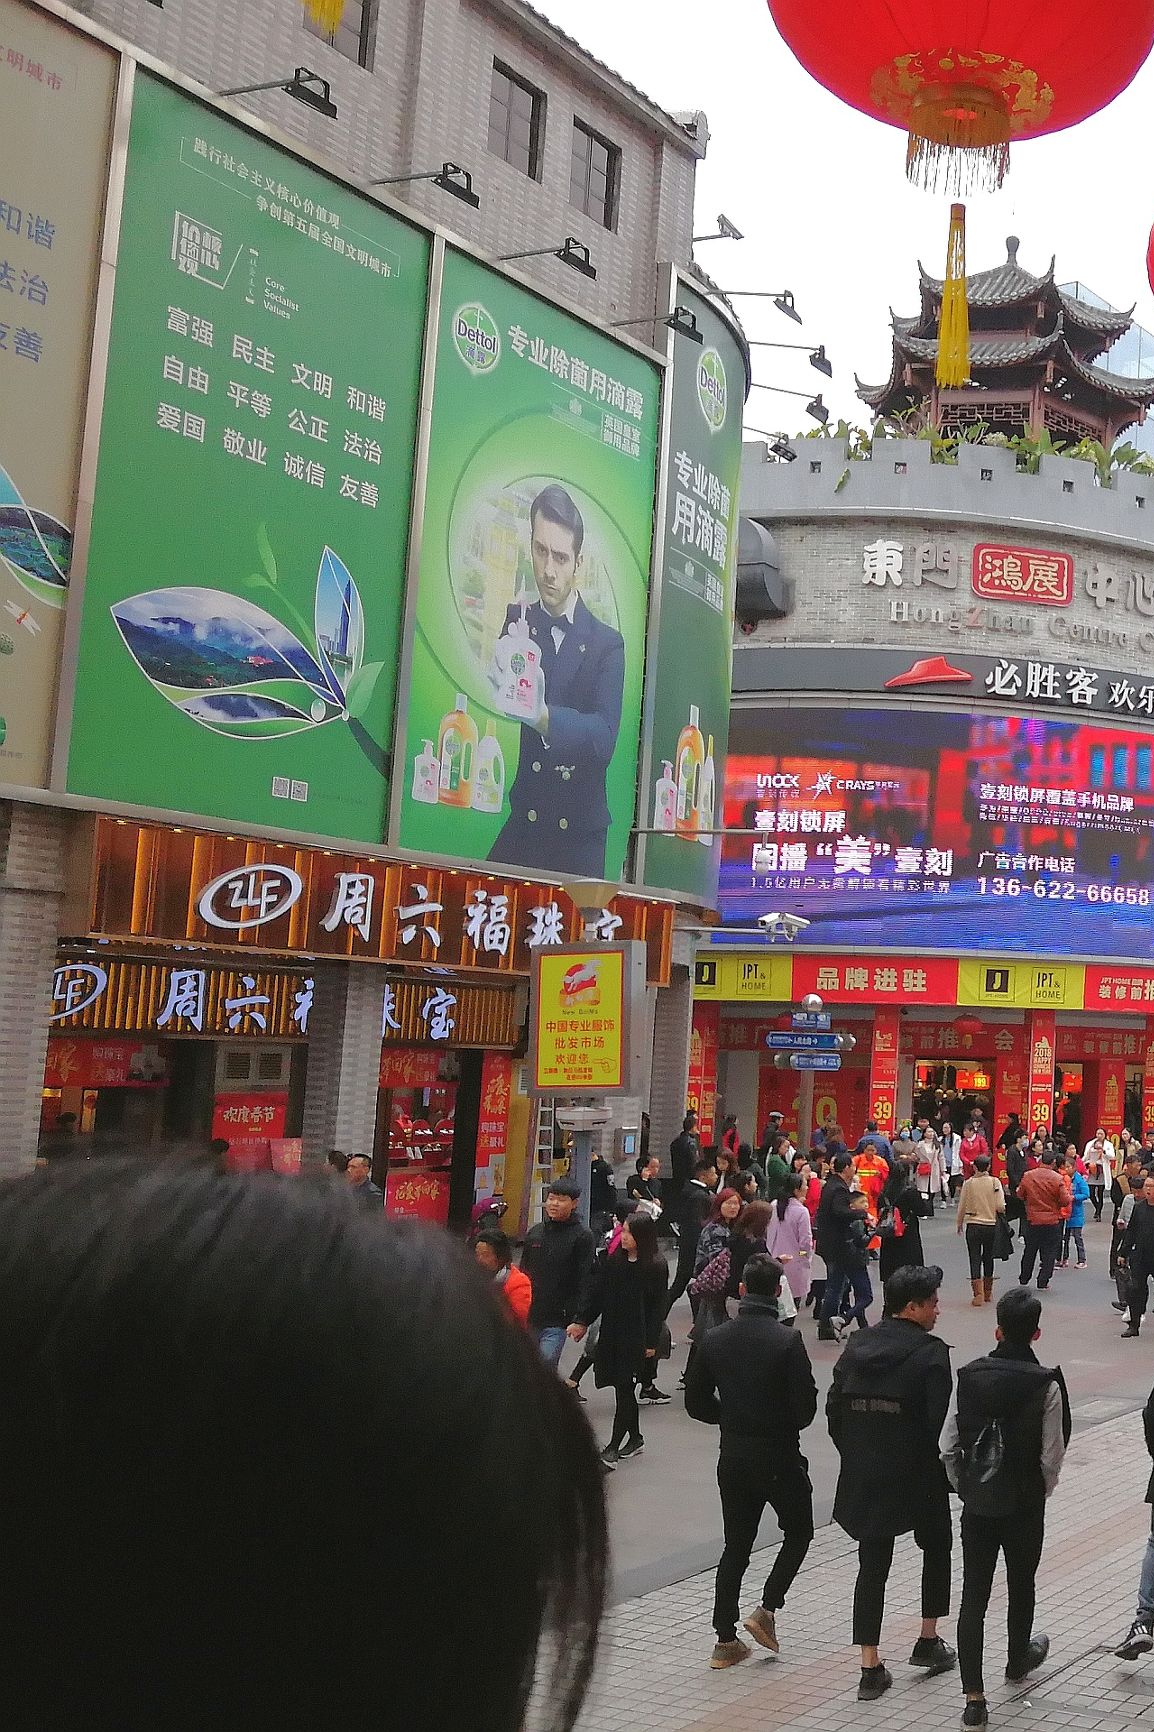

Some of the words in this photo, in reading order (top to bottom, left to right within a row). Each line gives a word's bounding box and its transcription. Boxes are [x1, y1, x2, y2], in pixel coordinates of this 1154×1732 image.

[0, 46, 63, 91] 明城市
[265, 277, 286, 292] Core
[263, 300, 291, 320] Values
[264, 288, 300, 312] Socialist
[457, 319, 498, 354] Dettol
[167, 304, 214, 348] 富强
[232, 334, 275, 374] 民主
[291, 362, 333, 399] 文明
[347, 385, 387, 422] 和谐
[508, 324, 644, 421] 专业除菌用滴露
[700, 367, 728, 403] Dettol
[163, 354, 209, 395] 自由
[227, 380, 272, 418] 平等
[288, 407, 329, 443] 公正
[343, 429, 382, 465] 法治
[156, 401, 206, 443] 爱国
[223, 427, 267, 466] 敬业
[283, 451, 325, 489] 诚信
[339, 474, 379, 508] 友善
[674, 450, 731, 522] 专业除菌
[672, 491, 728, 570] 用滴露
[862, 538, 958, 590] 東門
[889, 600, 1034, 635] HongZhan
[985, 658, 1099, 705] 必胜客
[836, 780, 875, 791] CRAYS
[980, 783, 1134, 813] 壹刻锁屏覆盖手机品牌
[754, 810, 847, 833] 壹刻锁屏
[977, 852, 1076, 874] 广告合作电话
[977, 876, 1149, 906] 136-622-66658
[742, 963, 759, 980] JPT
[816, 967, 928, 993] 品牌进驻
[1036, 972, 1053, 988] JPT
[741, 982, 766, 990] HOME
[1035, 990, 1061, 999] HOME
[1099, 985, 1142, 1000] 装修前
[546, 1020, 614, 1033] 中国专业服饰
[555, 1036, 604, 1049] 批发市场
[973, 1077, 986, 1087] 199
[223, 1105, 276, 1123] 欢度春节
[873, 1102, 892, 1119] 39
[1032, 1104, 1050, 1121] 39
